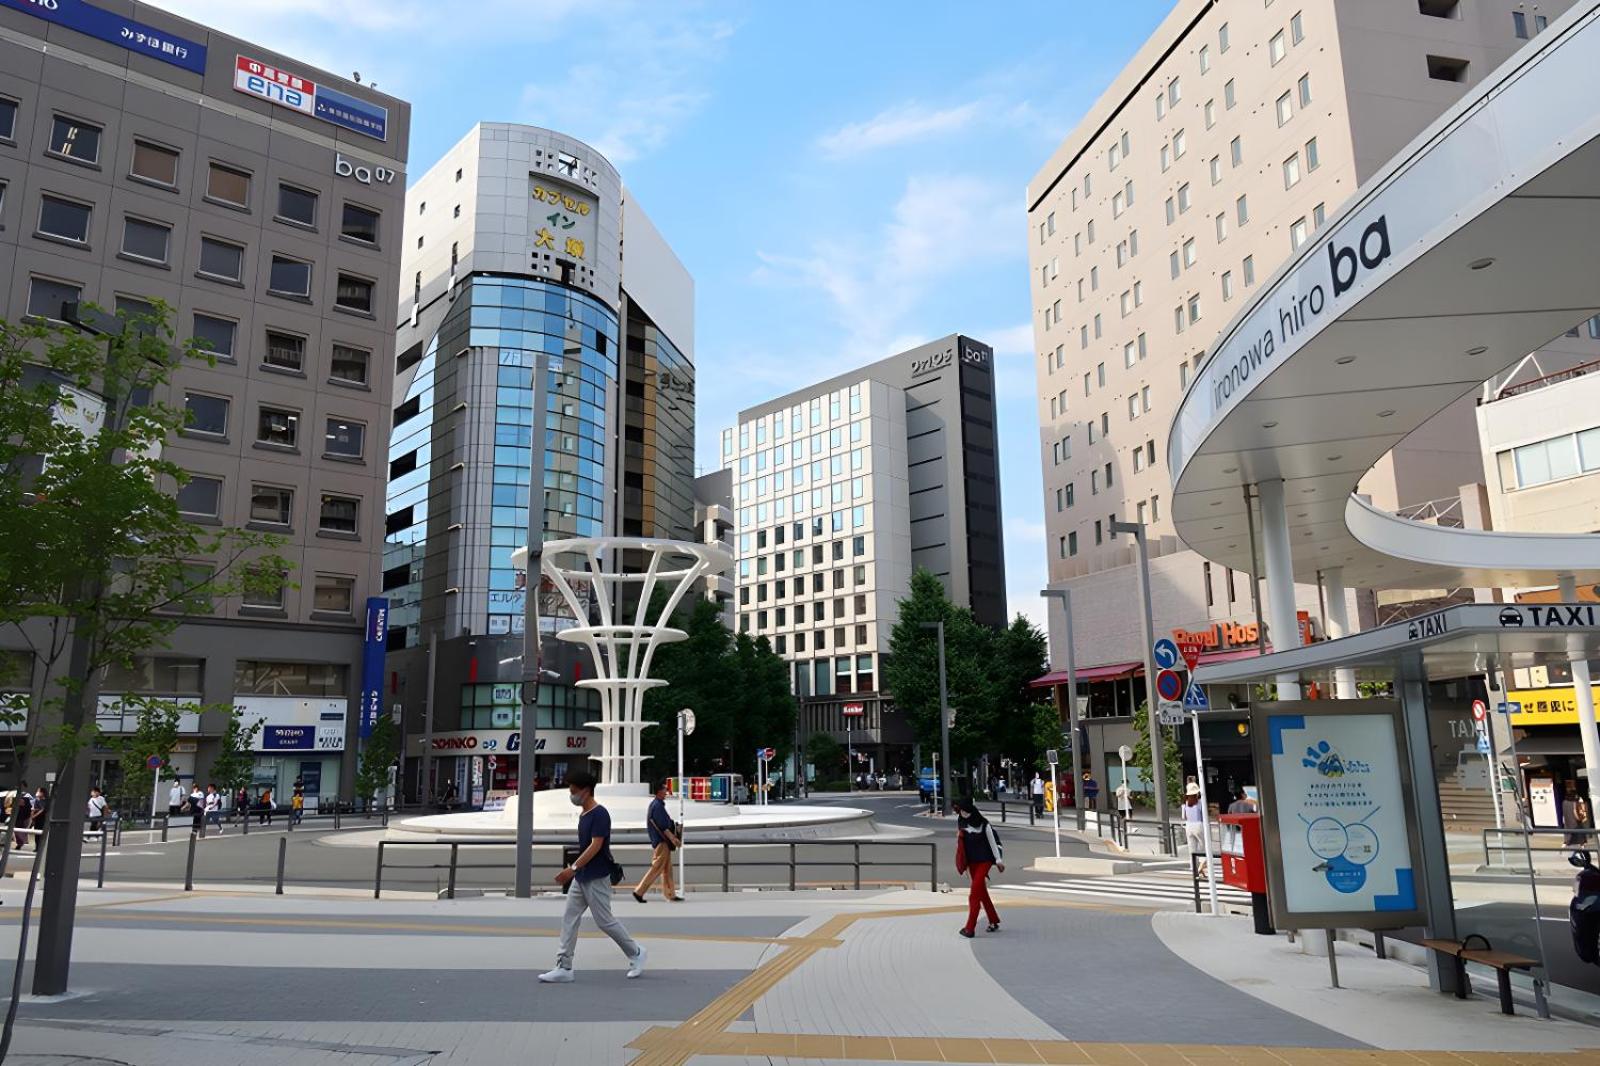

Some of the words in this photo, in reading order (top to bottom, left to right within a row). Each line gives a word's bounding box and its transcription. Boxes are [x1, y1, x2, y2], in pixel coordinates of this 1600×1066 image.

[247, 76, 302, 107] ena
[547, 212, 576, 230] イン
[1213, 329, 1275, 410] ironowa
[1418, 613, 1447, 639] TAXI
[1528, 606, 1596, 627] TAXI
[1448, 719, 1482, 739] TAX
